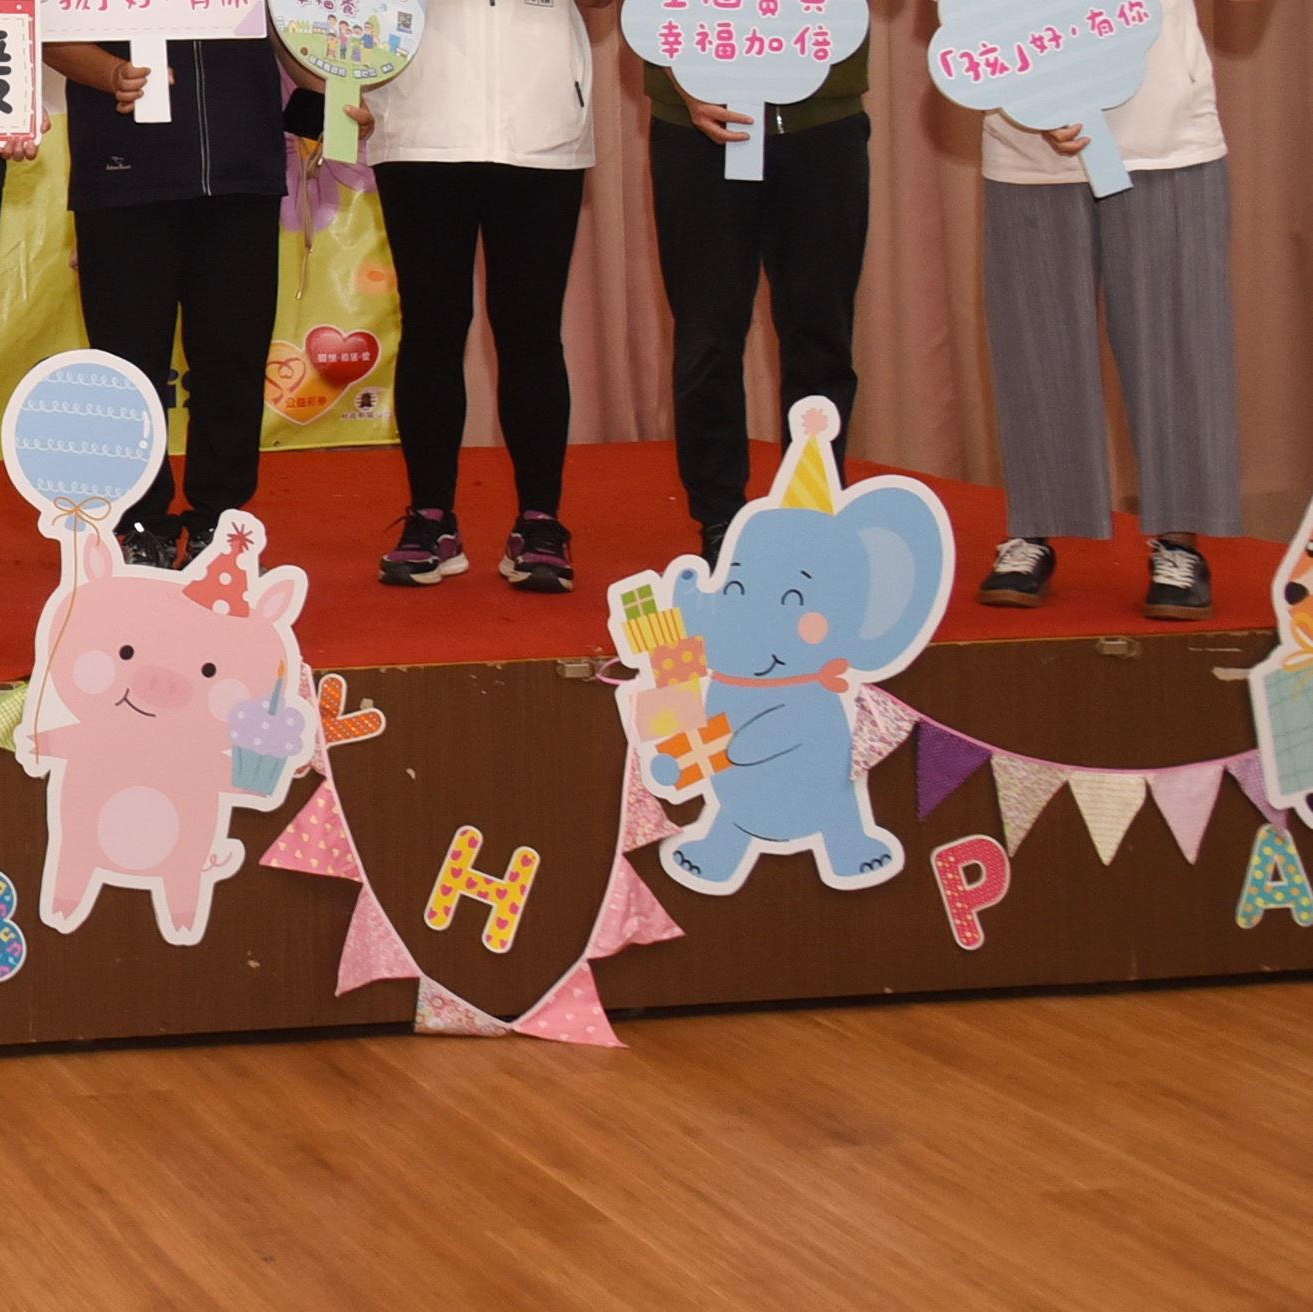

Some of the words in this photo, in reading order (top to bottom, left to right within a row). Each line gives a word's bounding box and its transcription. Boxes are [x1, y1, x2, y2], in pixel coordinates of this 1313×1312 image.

[658, 20, 831, 61] 幸福加倍
[423, 825, 540, 954] H
[930, 834, 1011, 950] P
[1235, 823, 1313, 929] A
